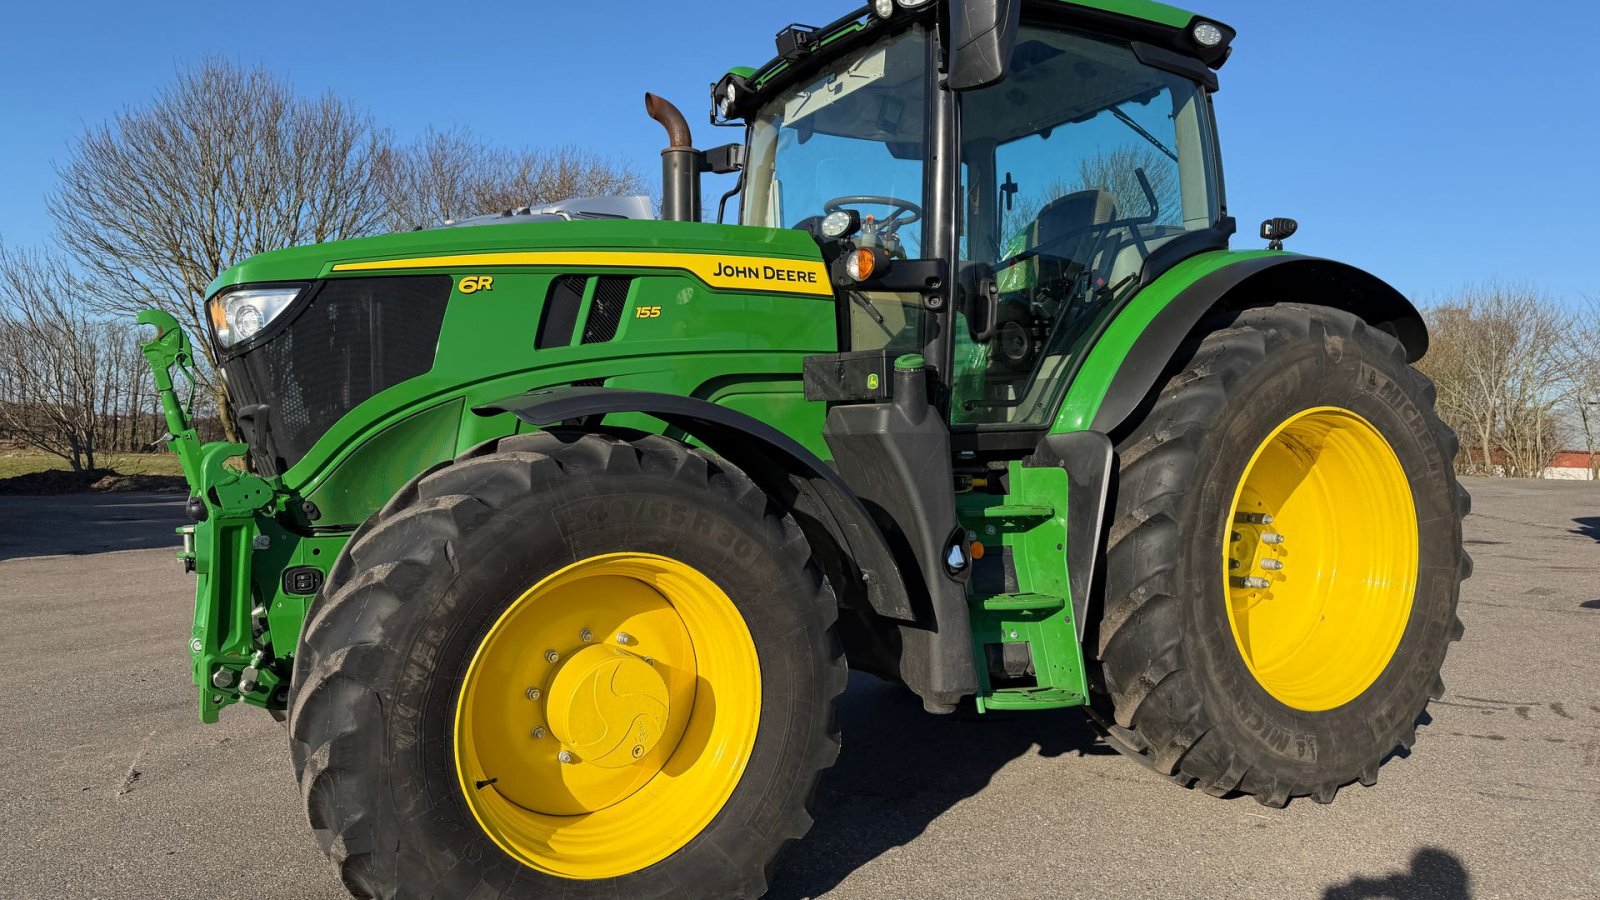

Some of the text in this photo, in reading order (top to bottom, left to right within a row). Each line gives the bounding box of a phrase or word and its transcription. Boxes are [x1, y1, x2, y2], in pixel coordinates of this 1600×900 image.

[713, 262, 817, 283] JOHN DEERE
[458, 275, 493, 294] 6R
[636, 305, 662, 319] 155
